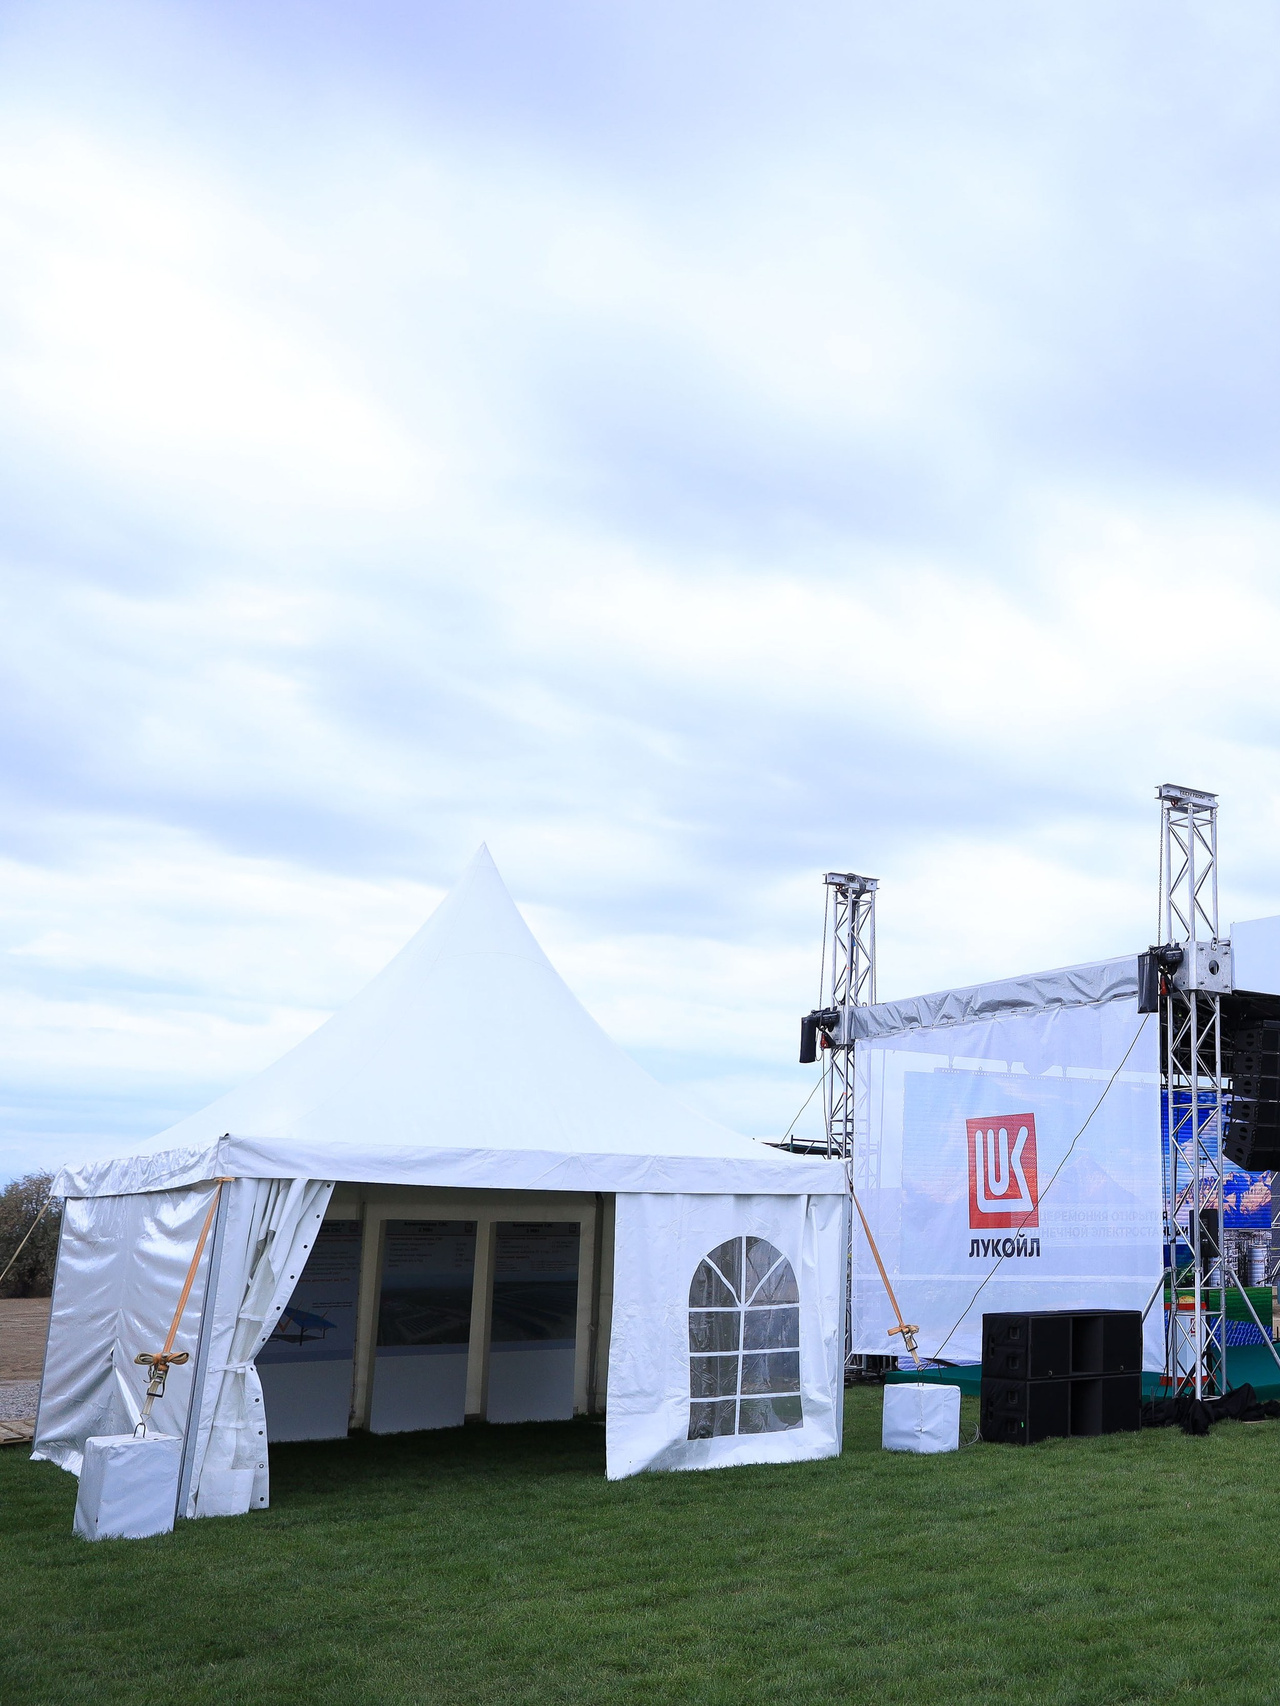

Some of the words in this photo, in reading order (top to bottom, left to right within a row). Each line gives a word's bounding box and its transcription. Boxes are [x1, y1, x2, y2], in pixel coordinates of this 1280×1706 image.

[1039, 1210, 1108, 1223] ЦЕРЕМОНИЯ
[1020, 1224, 1089, 1238] ОЛНЕЧНОЙ
[969, 1233, 1041, 1258] ЛУКОЙЛ
